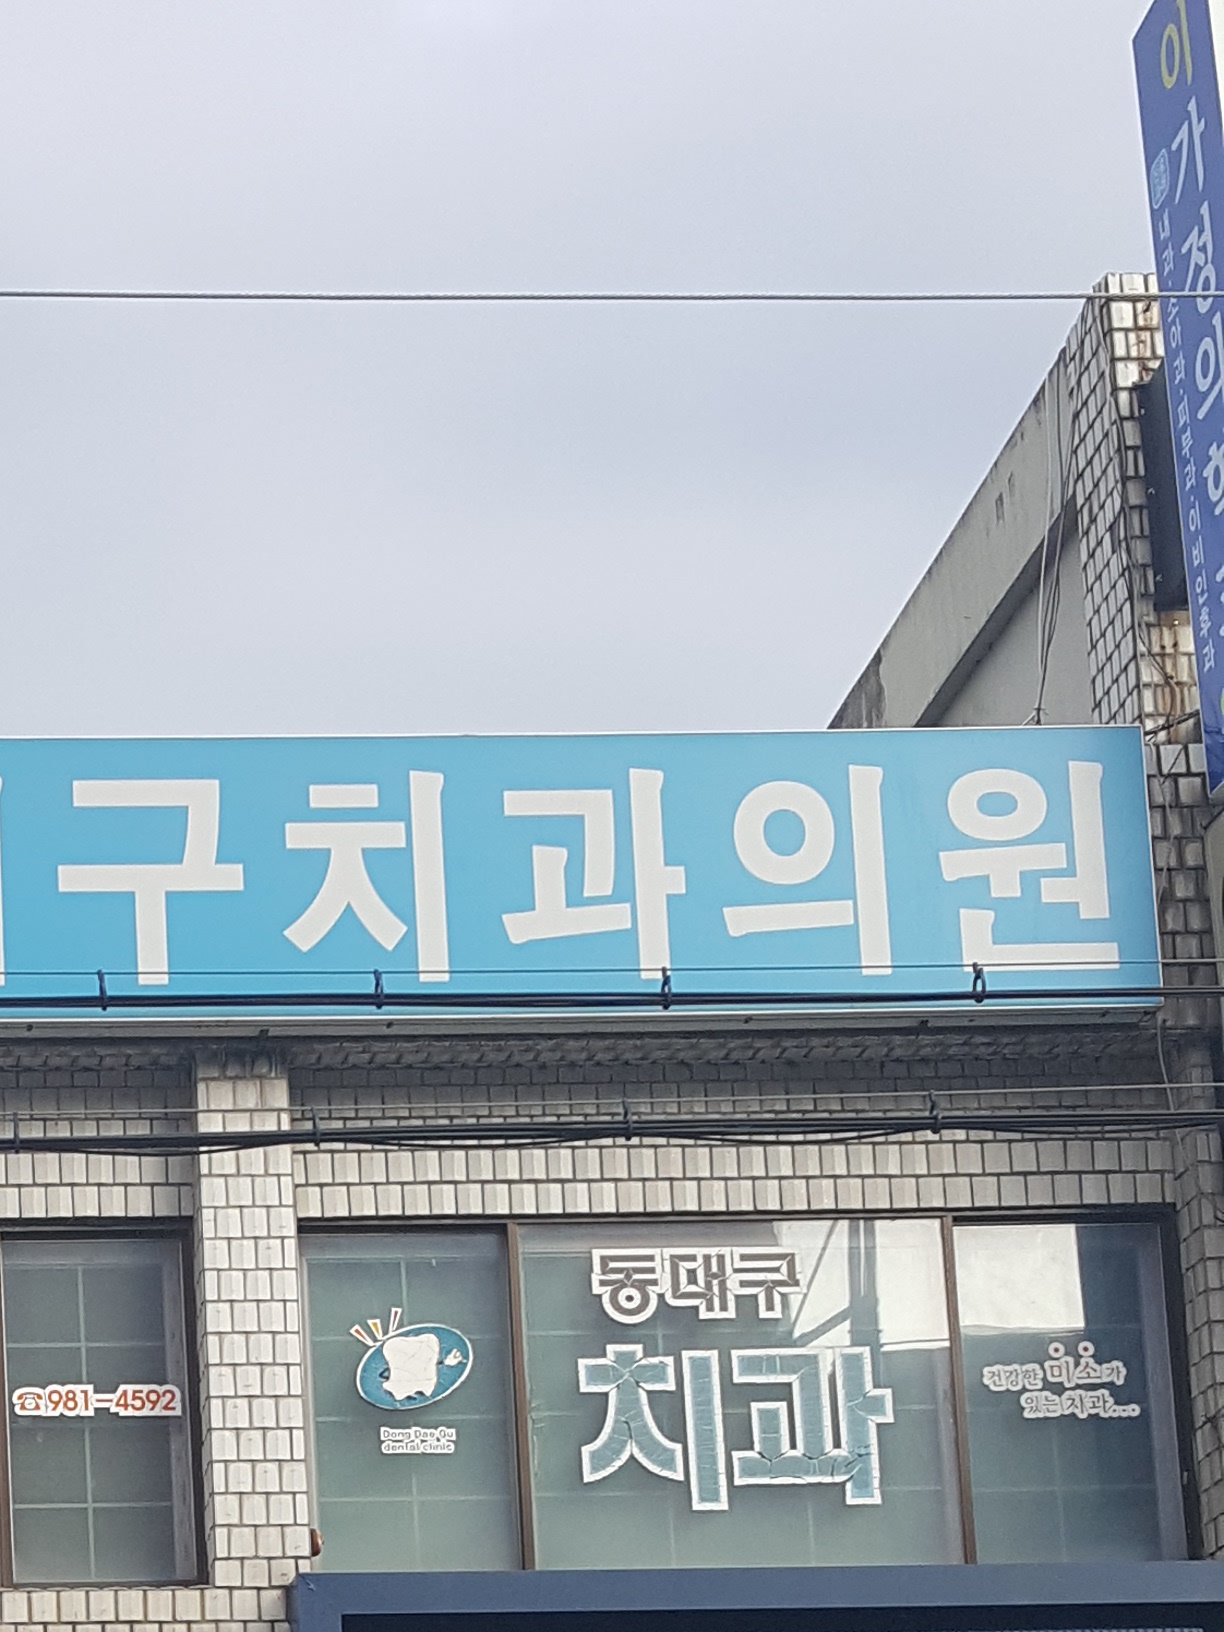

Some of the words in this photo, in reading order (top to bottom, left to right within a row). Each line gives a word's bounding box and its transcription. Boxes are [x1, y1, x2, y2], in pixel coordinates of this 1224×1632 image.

[592, 1248, 801, 1323] 동대구
[986, 1368, 1041, 1389] 건강한
[1048, 1359, 1124, 1385] 미소가
[46, 1388, 177, 1413] 981-4592
[1023, 1394, 1060, 1415] 있는
[382, 1428, 412, 1441] Dong
[579, 1344, 893, 1512] 치과
[382, 1441, 420, 1453] dental
[421, 1441, 454, 1453] clinic
